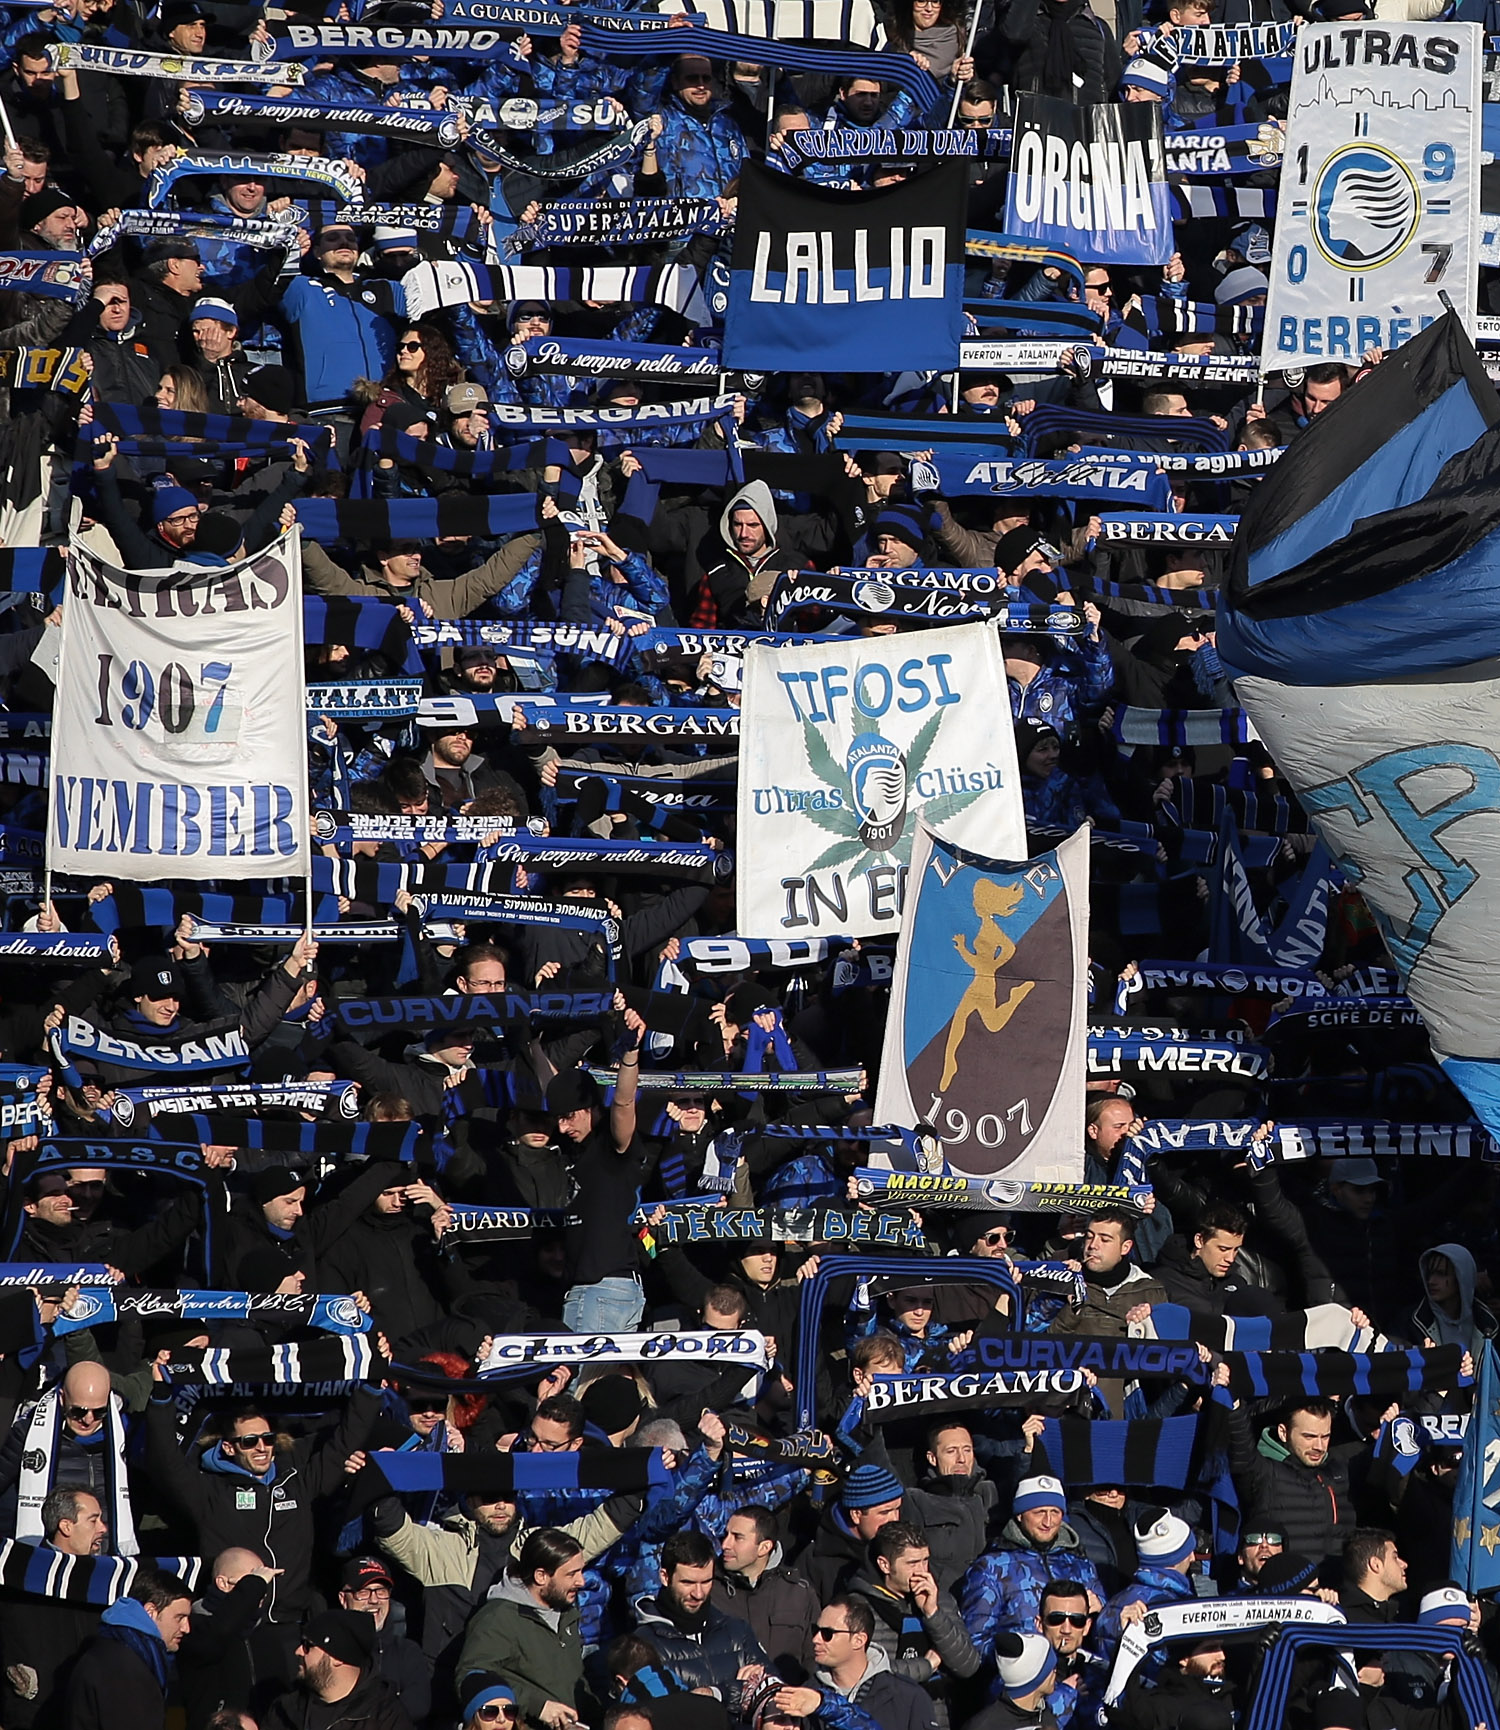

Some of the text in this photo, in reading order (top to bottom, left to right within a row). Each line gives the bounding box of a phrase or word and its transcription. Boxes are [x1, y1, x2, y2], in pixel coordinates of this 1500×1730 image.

[469, 3, 559, 25] GUARDIA
[288, 25, 499, 52] BERGAMO
[1303, 29, 1460, 77] ULTRAS
[213, 96, 432, 133] Per sempre nella storia
[796, 130, 978, 159] GUARDIA DI UNA
[1296, 142, 1456, 185] 1 9
[335, 214, 439, 229] BERGAMASCA CALCIO
[547, 203, 721, 233] SUPER ATALANTA
[546, 228, 671, 243] SEMPRE NEL NOSTRO
[750, 226, 947, 304] LALLIO
[1287, 242, 1454, 285] 0 7
[533, 342, 682, 375] Per sempre nella
[963, 349, 1059, 361] EVERTON ATALANTA
[1101, 360, 1201, 379] INSIEME PER
[495, 391, 742, 426] BERGAMO
[1194, 452, 1243, 473] agli
[97, 653, 234, 735] 1907
[777, 654, 962, 724] TIFOSI
[847, 742, 899, 765] ATALANTA
[752, 762, 1005, 816] Ultras Clüsù
[864, 823, 894, 841] 1907
[780, 877, 850, 929] IN
[42, 938, 102, 959] storia
[338, 996, 501, 1026] CURVA
[1307, 1010, 1394, 1029] SCIFE DE
[148, 1090, 326, 1115] INSIEME PER SEMPRE
[923, 1091, 1035, 1149] 1907
[1279, 1126, 1472, 1160] BELLINI
[885, 1173, 968, 1191] MAGICA
[1038, 1198, 1062, 1211] per
[1, 1267, 55, 1286] nella
[978, 1336, 1108, 1367] CURVA
[866, 1368, 1083, 1412] BERGAMO
[1182, 1608, 1315, 1625] EVERTON ATALANTA B.C.
